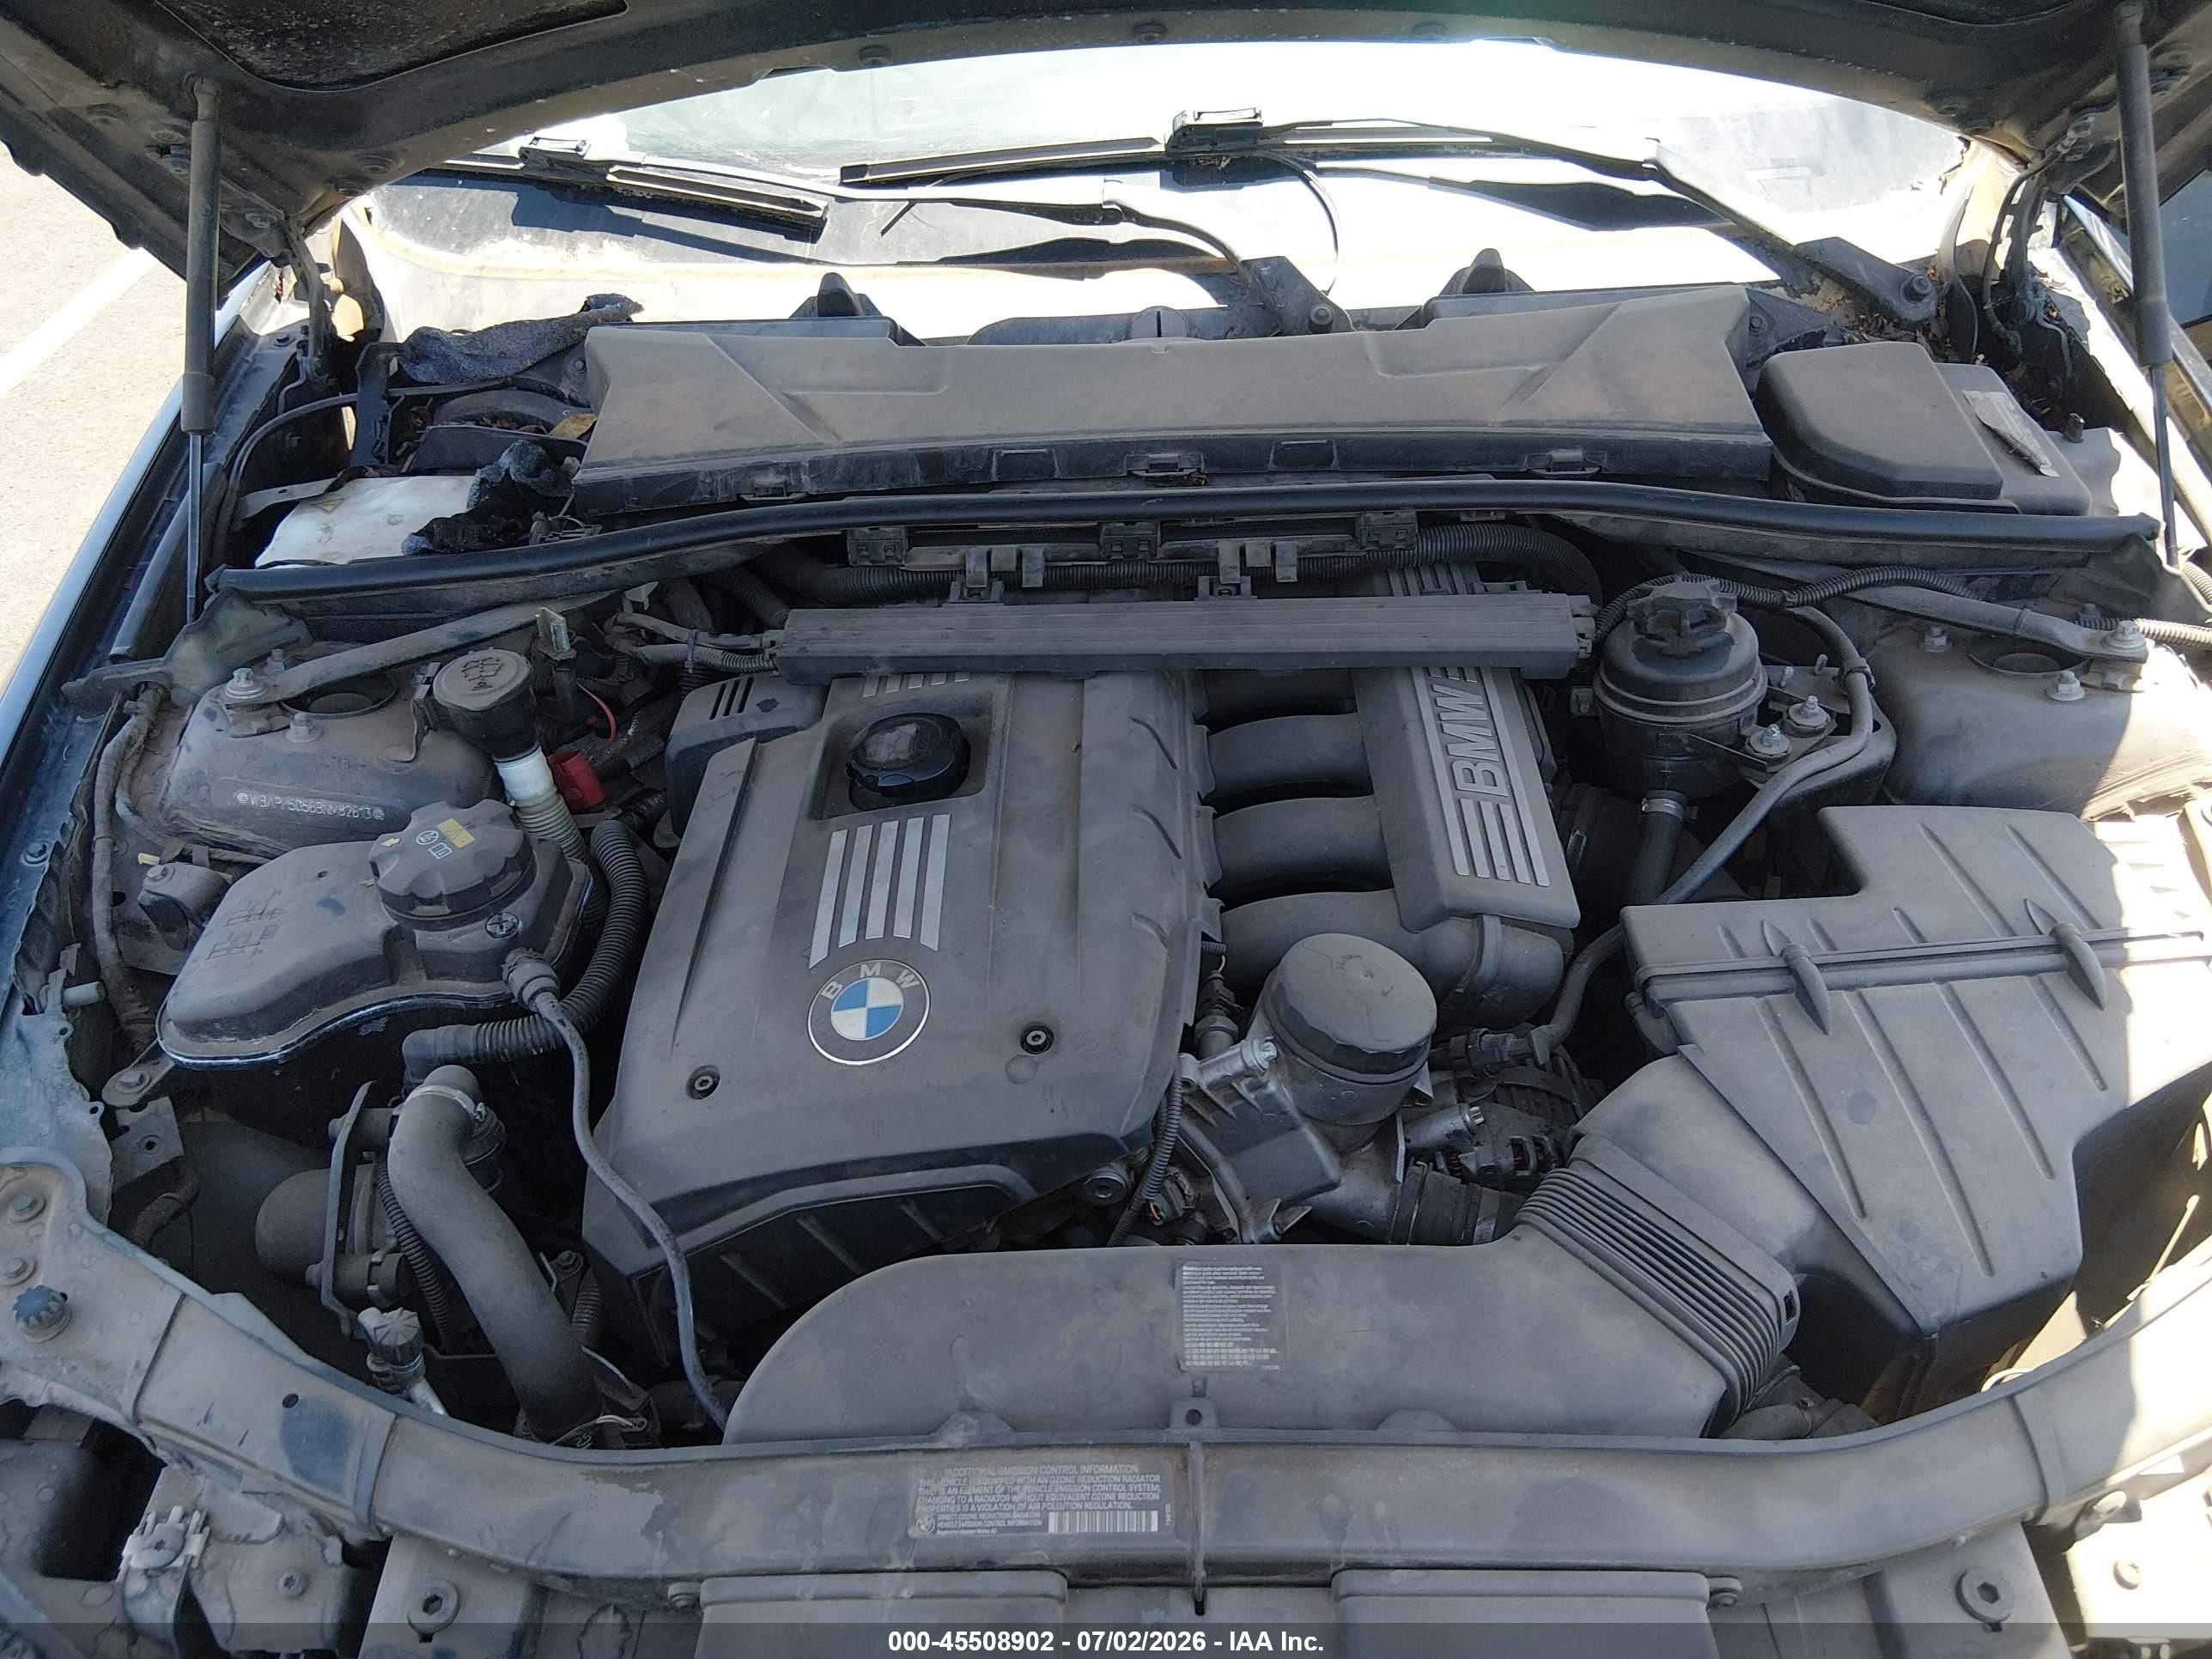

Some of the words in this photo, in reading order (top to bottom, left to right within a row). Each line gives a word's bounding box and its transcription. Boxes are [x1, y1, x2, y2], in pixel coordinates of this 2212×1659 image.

[1431, 684, 1510, 797] BMW
[821, 963, 920, 1000] BMW
[1040, 1466, 1079, 1474] CONTROL
[1080, 1465, 1139, 1474] INFORMATION
[1122, 1474, 1161, 1483] RADIATOR
